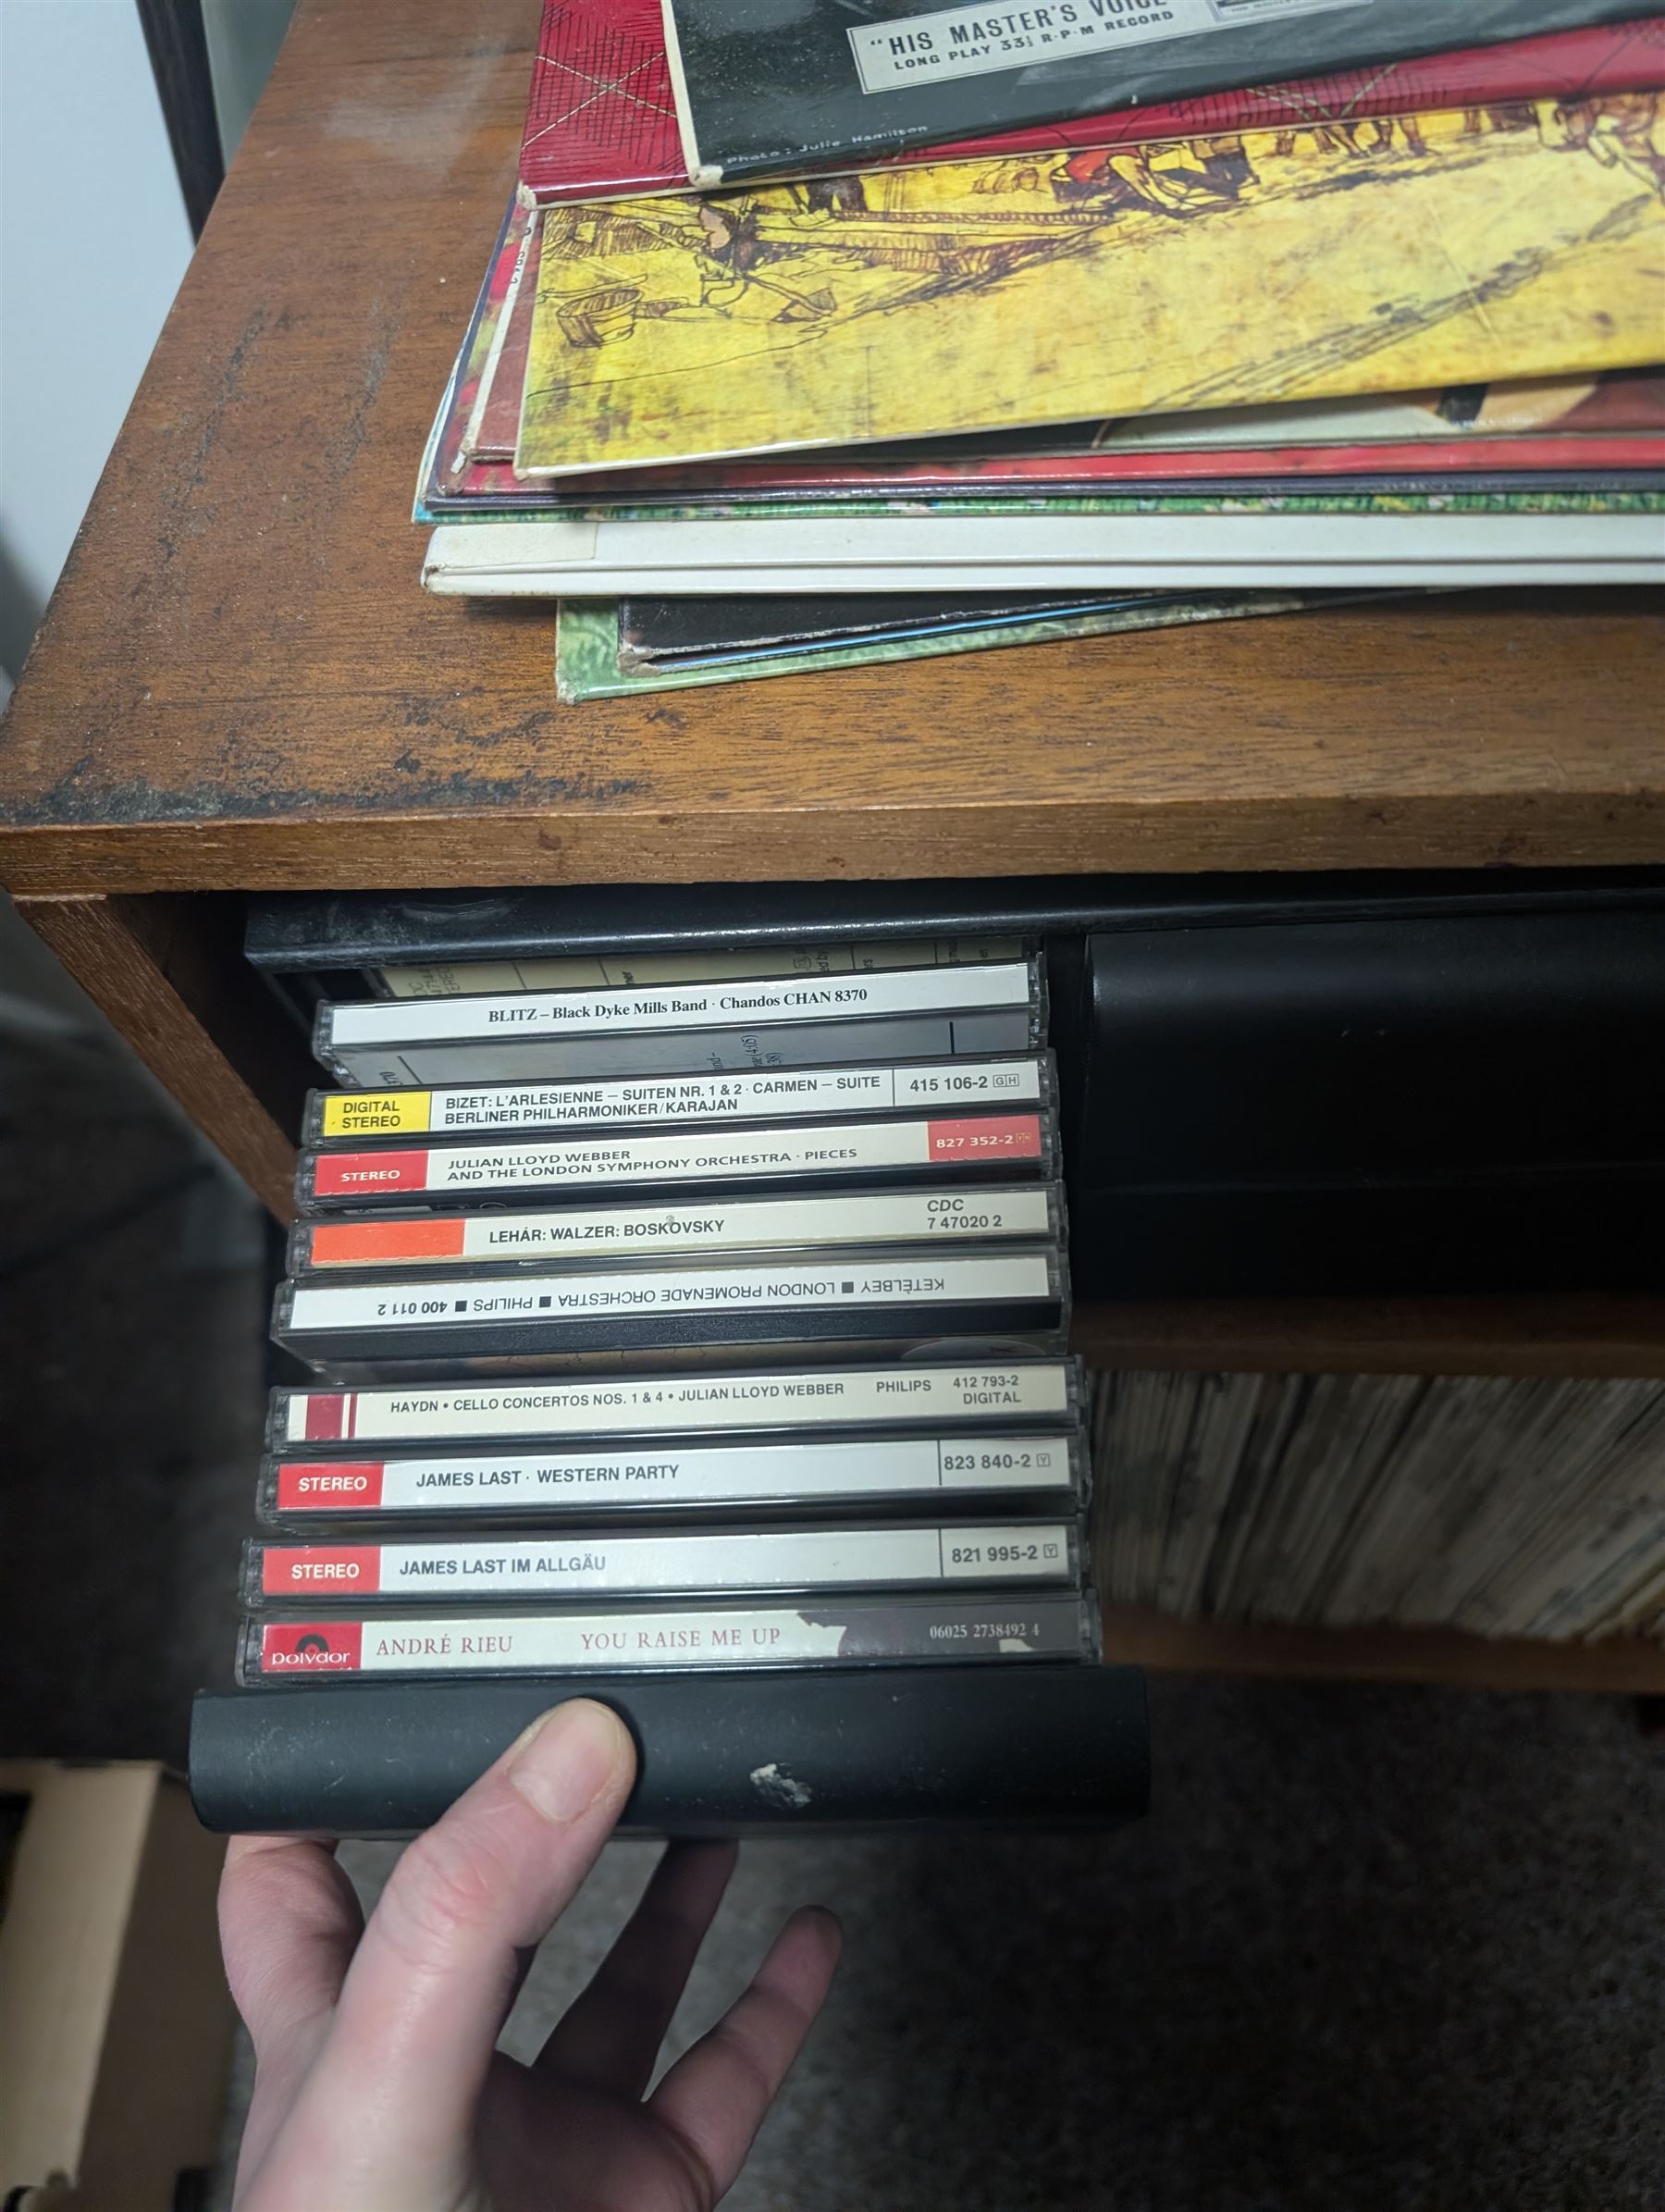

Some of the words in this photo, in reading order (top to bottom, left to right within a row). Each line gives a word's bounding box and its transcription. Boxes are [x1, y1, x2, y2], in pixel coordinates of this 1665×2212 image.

[894, 55, 940, 69] LONG
[948, 45, 990, 60] PLAY
[1104, 8, 1173, 31] RECORD
[800, 141, 840, 152] Julie
[852, 126, 928, 142] Hamilton
[489, 1008, 536, 1022] BLITZ
[553, 1007, 590, 1019] Black
[596, 1005, 629, 1019] Dyke
[635, 1002, 667, 1014] Mills
[672, 999, 707, 1012] Band
[721, 995, 780, 1009] Chandos
[784, 991, 831, 1005] CHAN
[835, 989, 867, 1002] 8370
[910, 1079, 938, 1092] 415
[944, 1076, 988, 1090] 106-2
[447, 1096, 492, 1109] BIZET:
[623, 1087, 675, 1100] SUITEN
[681, 1086, 704, 1097] NR.
[709, 1085, 714, 1095] 1
[721, 1084, 730, 1095] &
[734, 1084, 741, 1094] 2
[753, 1080, 817, 1094] CARMEN
[837, 1076, 880, 1089] SUITE
[343, 1101, 400, 1113] DIGITAL
[446, 1110, 519, 1124] BERLINER
[522, 1096, 740, 1121] PHILHARMONIKER/KARAJAN
[342, 1116, 401, 1129] STEREO
[937, 1138, 964, 1147] 827
[970, 1135, 1013, 1145] 352-2
[448, 1171, 483, 1180] AND
[487, 1169, 517, 1178] THE
[524, 1165, 591, 1176] LONDON
[598, 1159, 690, 1172] SYMPHONY
[696, 1154, 791, 1167] ORCHESTRA
[806, 1149, 857, 1159] PIECES
[449, 1158, 503, 1168] JULIAN
[509, 1155, 560, 1166] LLOYD
[565, 1151, 630, 1162] WEBBER
[342, 1170, 400, 1181] STEREO
[928, 1199, 964, 1212] CDC
[928, 1217, 935, 1229] 7
[941, 1216, 988, 1229] 47020
[993, 1215, 1002, 1227] 2
[490, 1227, 546, 1243] LEHÁR:
[550, 1226, 619, 1240] WALZER:
[623, 1219, 724, 1237] BOSKOVSKY
[660, 1286, 761, 1302] PROMENADE
[768, 1282, 834, 1296] LONDON
[474, 1297, 533, 1311] PHILIPS
[559, 1291, 655, 1306] ORCHESTRA
[378, 1304, 386, 1316] 2
[393, 1303, 416, 1315] 011
[422, 1302, 448, 1314] 400
[954, 1377, 977, 1388] 412
[981, 1375, 1018, 1387] 793-2
[391, 1401, 438, 1412] HAYDN
[454, 1399, 499, 1411] CELLO
[503, 1395, 588, 1409] CONCERTOS
[594, 1393, 626, 1405] NOS.
[632, 1393, 636, 1403] 1
[643, 1392, 650, 1403] &
[656, 1391, 662, 1402] 4
[679, 1389, 728, 1401] JULIAN
[733, 1386, 779, 1398] LLOYD
[783, 1383, 844, 1396] WEBBER
[877, 1380, 931, 1392] PHILIPS
[964, 1391, 1021, 1404] DIGITAL
[944, 1455, 975, 1470] 823
[981, 1454, 1030, 1468] 840-2
[416, 1473, 474, 1487] JAMES
[479, 1471, 522, 1485] LAST
[537, 1467, 619, 1483] WESTERN
[625, 1464, 680, 1482] PARTY
[299, 1477, 367, 1491] STEREO
[952, 1548, 980, 1563] 821
[988, 1545, 1038, 1562] 995-2
[292, 1563, 359, 1579] STEREO
[400, 1561, 457, 1575] JAMES
[463, 1560, 506, 1574] LAST
[512, 1559, 530, 1573] IM
[536, 1554, 605, 1572] ALLGÄU
[581, 1633, 626, 1650] YOU
[638, 1631, 700, 1648] RAISE
[712, 1629, 741, 1645] ME
[753, 1628, 780, 1644] UP
[930, 1625, 967, 1638] 06025
[974, 1624, 1026, 1637] 2738492
[1032, 1624, 1039, 1636] 4
[376, 1634, 450, 1655] ANDRÉ
[462, 1637, 512, 1653] RIEU
